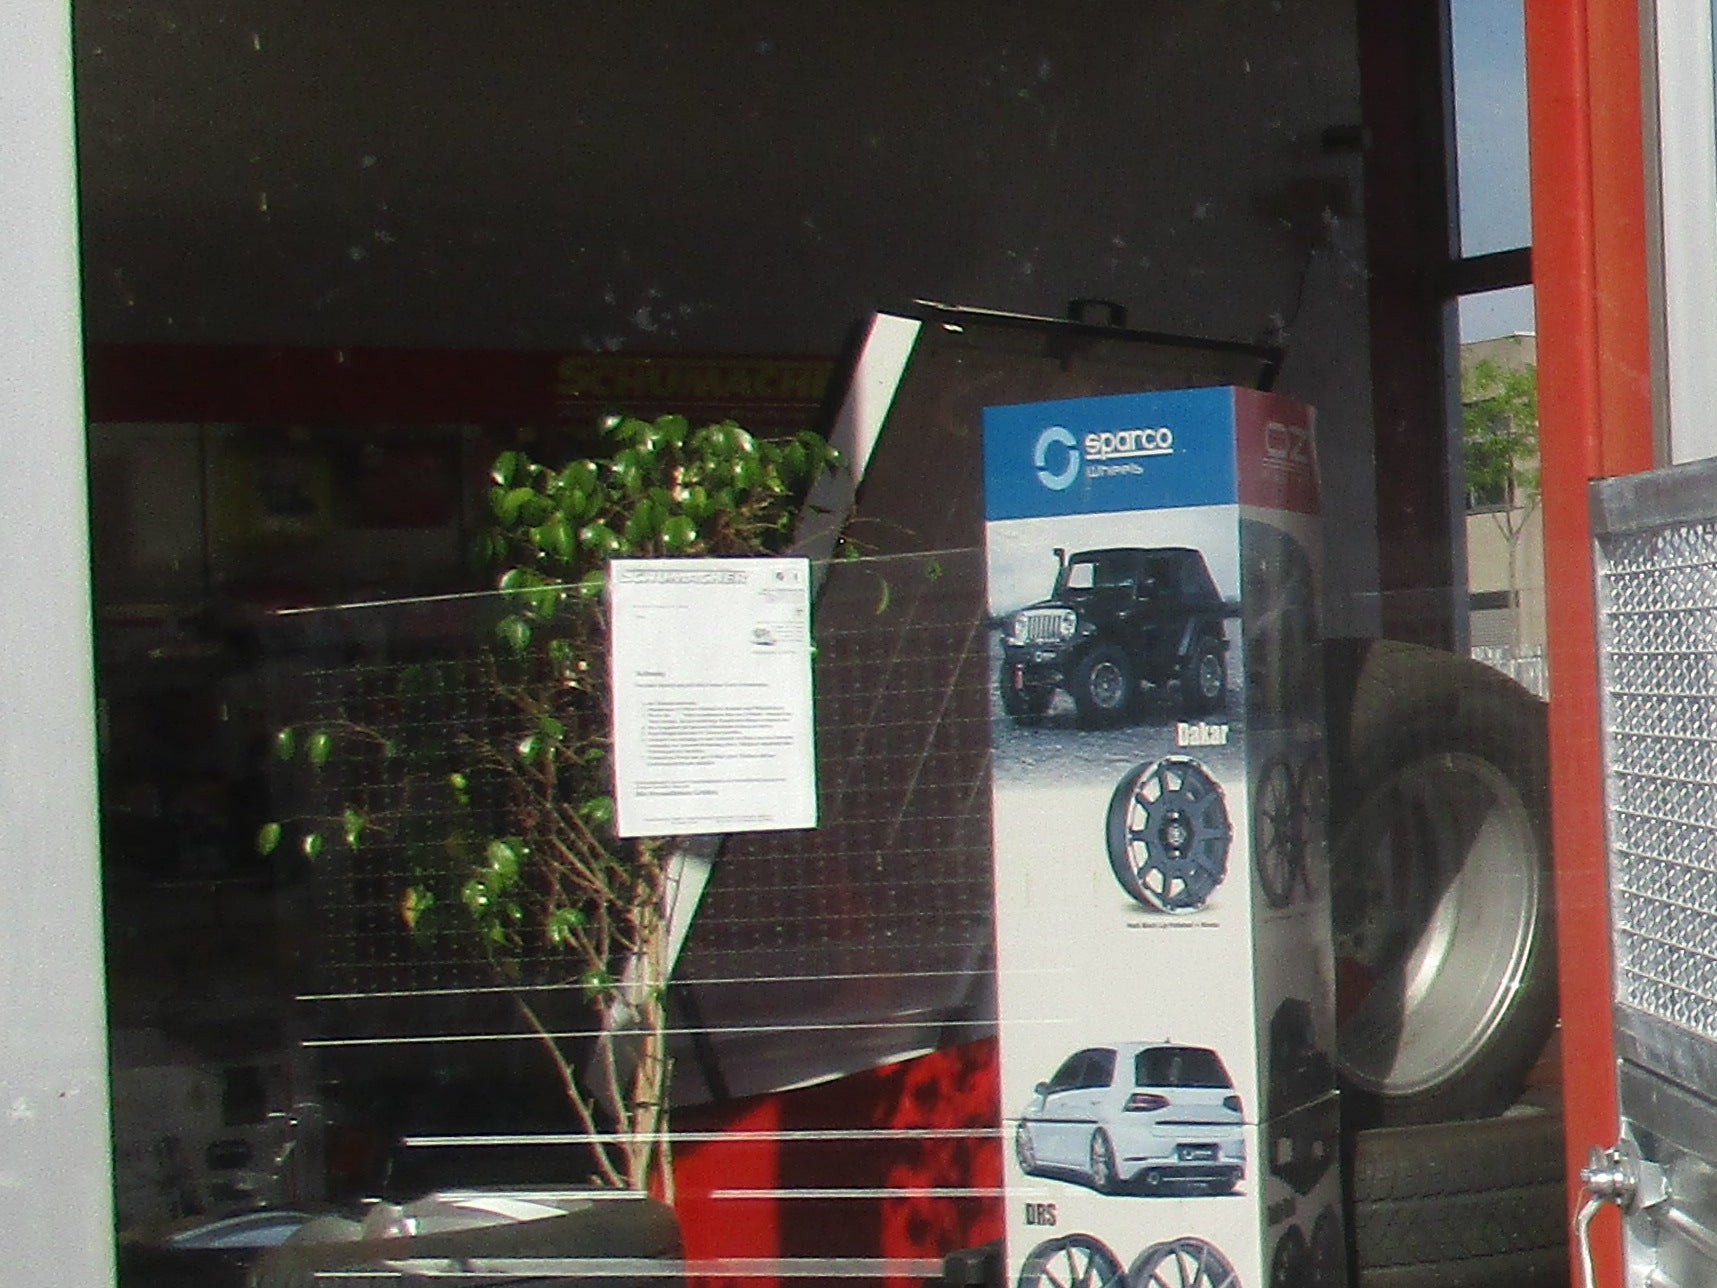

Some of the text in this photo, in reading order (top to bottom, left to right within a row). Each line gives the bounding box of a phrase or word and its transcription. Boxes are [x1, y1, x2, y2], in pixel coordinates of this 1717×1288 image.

[1085, 427, 1174, 460] sparco
[1176, 721, 1230, 746] Dakar
[1025, 1202, 1058, 1227] DRS
